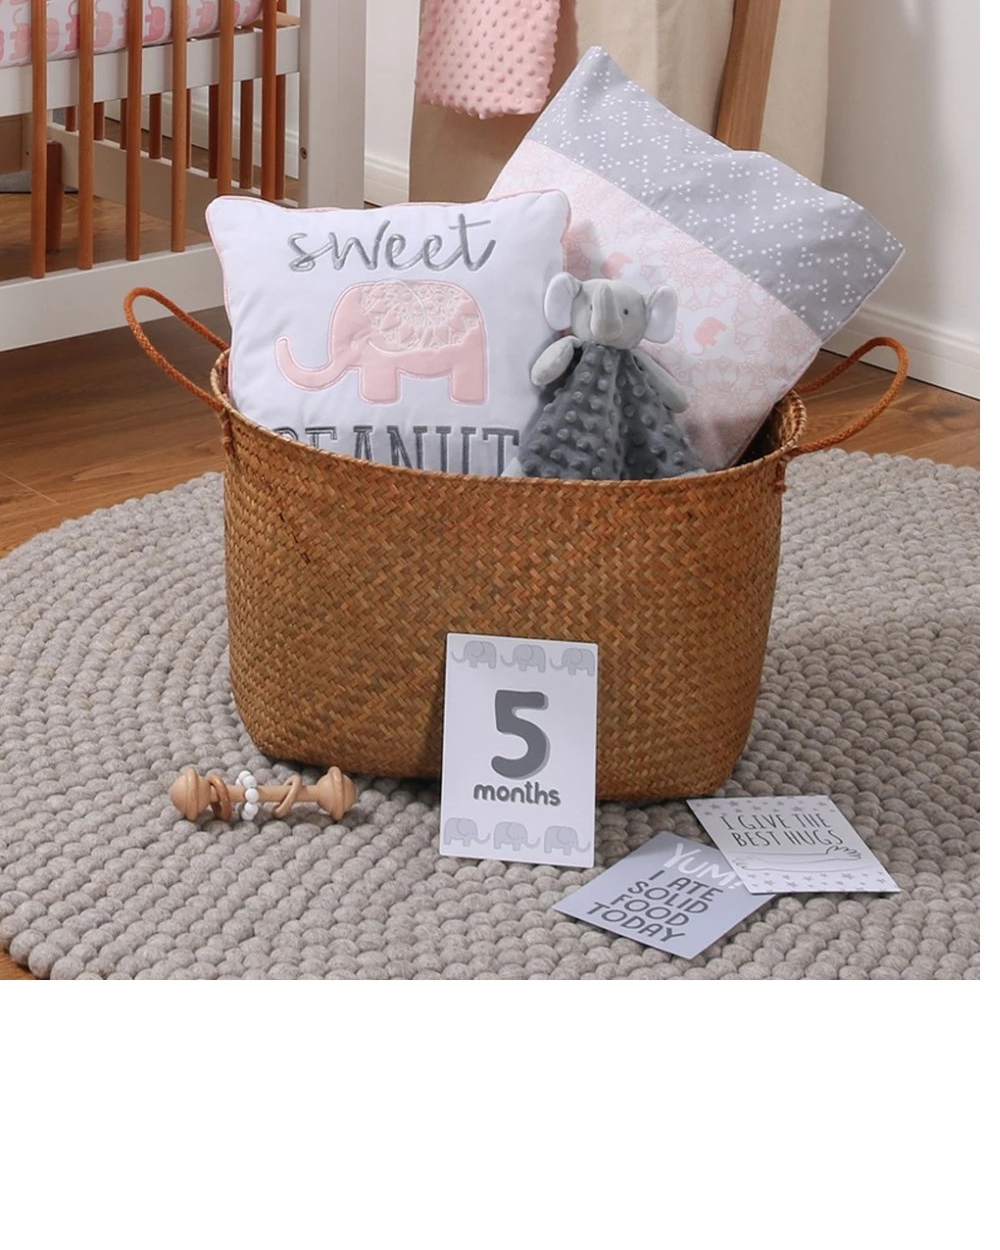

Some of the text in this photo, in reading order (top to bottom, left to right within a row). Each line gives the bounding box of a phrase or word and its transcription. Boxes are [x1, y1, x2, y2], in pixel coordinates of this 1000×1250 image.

[287, 213, 497, 273] sweet
[273, 425, 520, 477] ANUT
[491, 689, 551, 780] 5
[473, 781, 561, 807] months
[720, 813, 832, 830] I GIVE THE
[731, 829, 844, 847] BEST HUGS
[627, 880, 709, 914] SOLID
[648, 870, 724, 902] I ATE
[586, 902, 686, 943] TODAY
[610, 894, 690, 927] FOOD
